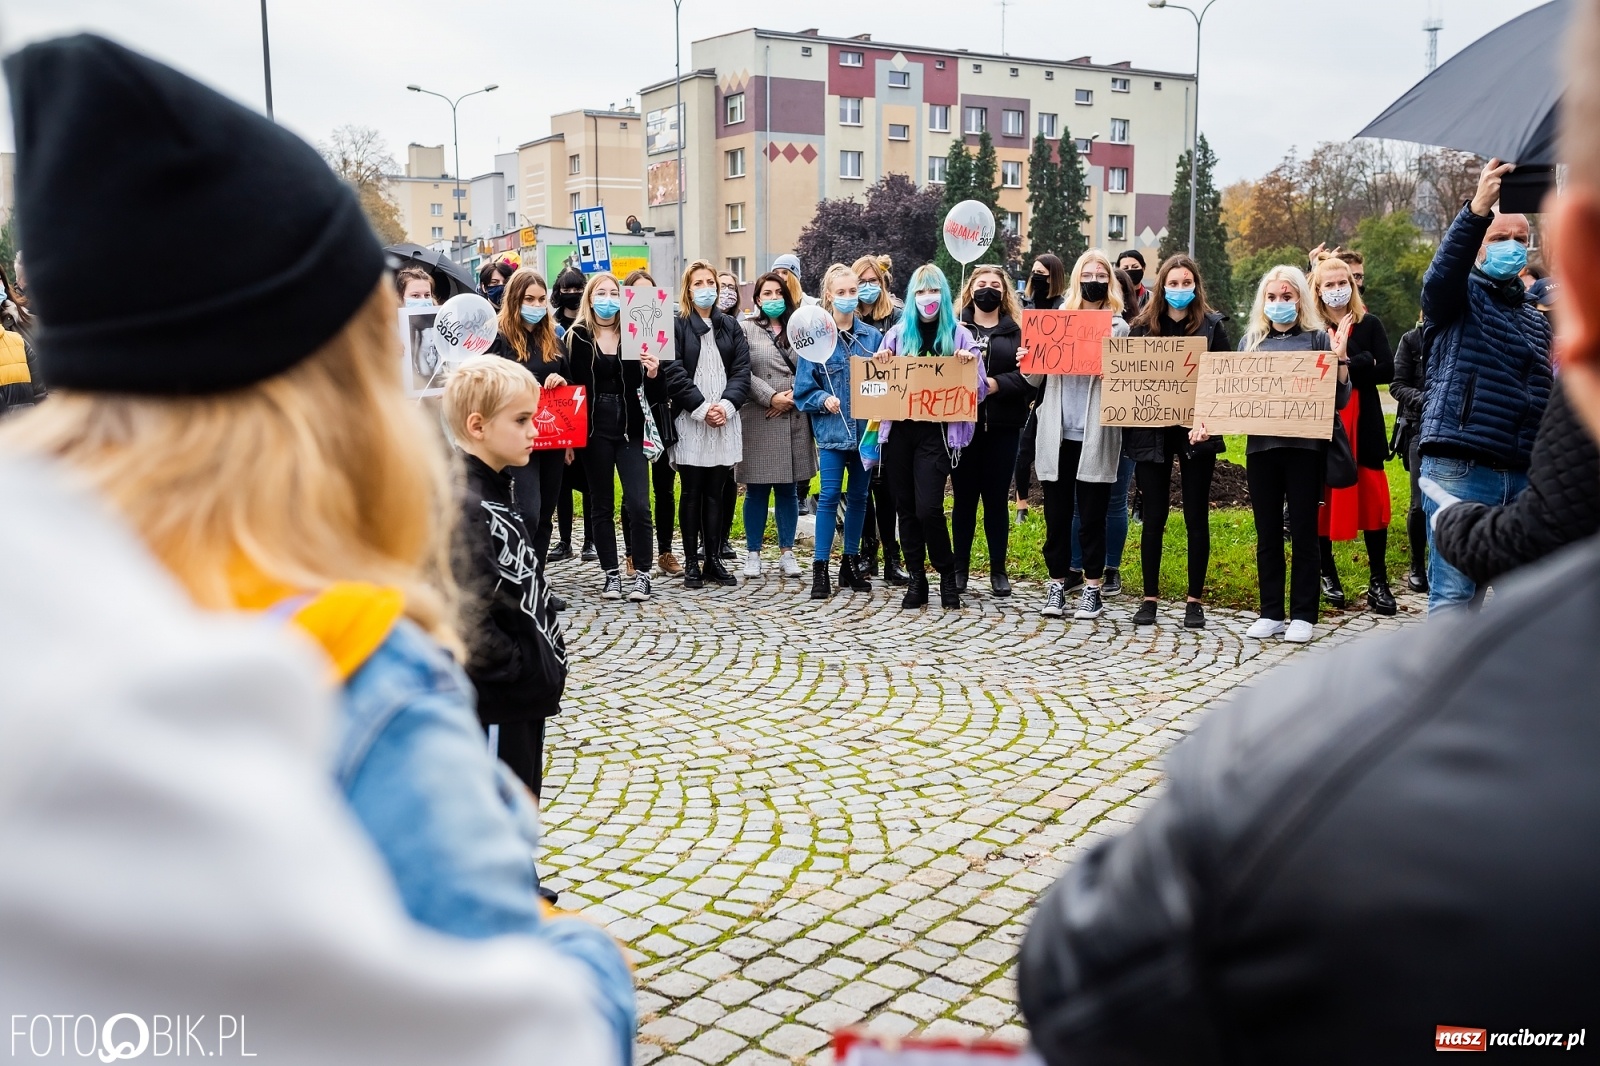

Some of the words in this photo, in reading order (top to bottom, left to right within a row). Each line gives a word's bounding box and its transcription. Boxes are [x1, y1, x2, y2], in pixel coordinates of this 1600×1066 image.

[436, 320, 459, 346] 2020
[1025, 314, 1077, 343] MOJE
[793, 336, 815, 350] 2020
[1109, 338, 1135, 354] NIE
[1144, 339, 1185, 354] MACIE
[1031, 340, 1075, 373] MÓJ
[1212, 356, 1280, 375] WALCZCIE
[1291, 357, 1307, 373] Z
[863, 359, 900, 381] Don't
[1110, 359, 1175, 374] SUMIENIA
[889, 383, 908, 400] my
[1109, 377, 1189, 395] ZMUSZAJĄC
[1215, 376, 1287, 395] WIRUSEM,
[1291, 376, 1320, 394] NIE
[554, 399, 574, 407] TEGO
[1134, 393, 1161, 407] NAS
[1103, 406, 1127, 422] DO
[1131, 406, 1195, 423] RODZENIA
[1208, 401, 1219, 418] Z
[1229, 400, 1325, 421] KOBIETAMI
